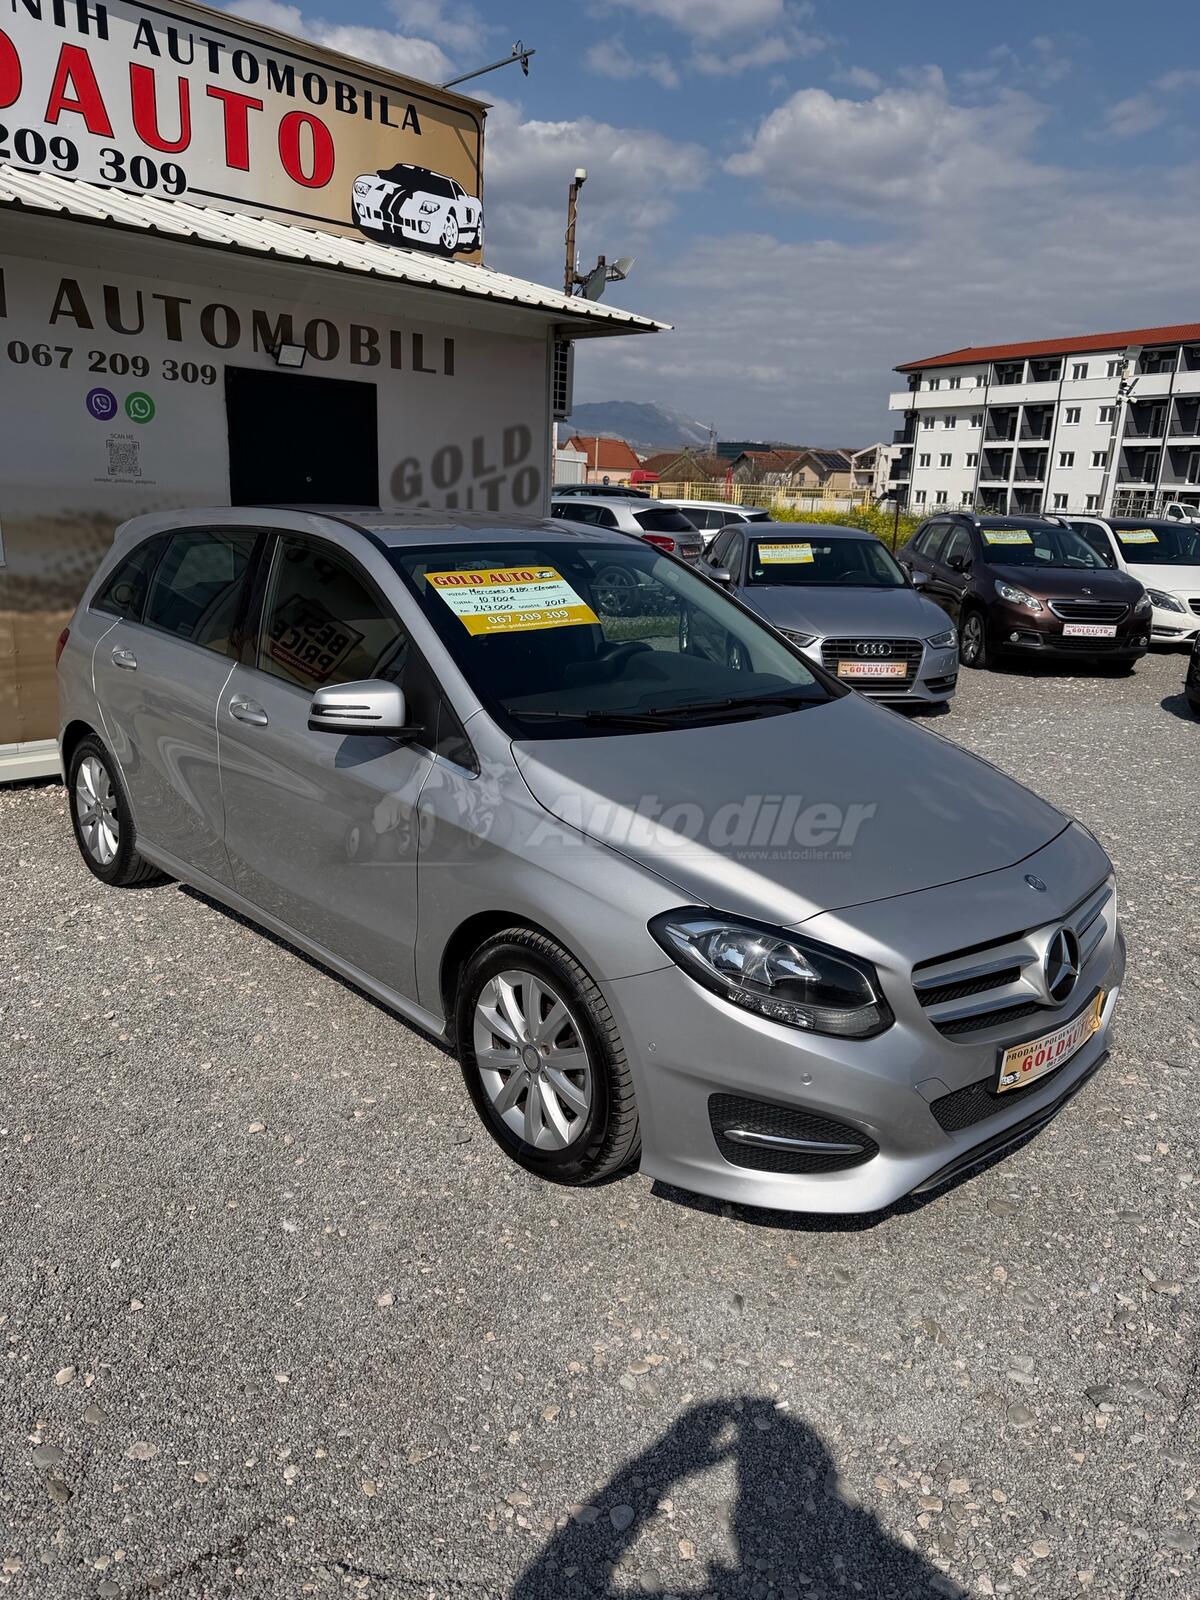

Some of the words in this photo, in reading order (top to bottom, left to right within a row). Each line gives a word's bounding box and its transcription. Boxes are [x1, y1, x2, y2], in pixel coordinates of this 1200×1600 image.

[133, 17, 422, 136] AUTOMOBILA
[99, 147, 188, 196] 309
[49, 277, 455, 377] AUTOMOBILI
[7, 341, 74, 369] 067
[88, 350, 150, 378] 209
[162, 359, 217, 385] 309
[389, 423, 532, 504] GOLD
[433, 574, 484, 586] GOLD
[489, 571, 535, 584] AUTO
[487, 614, 512, 624] 067
[516, 612, 541, 621] 209
[543, 610, 569, 619] 309
[1006, 1043, 1042, 1062] PRODAJA
